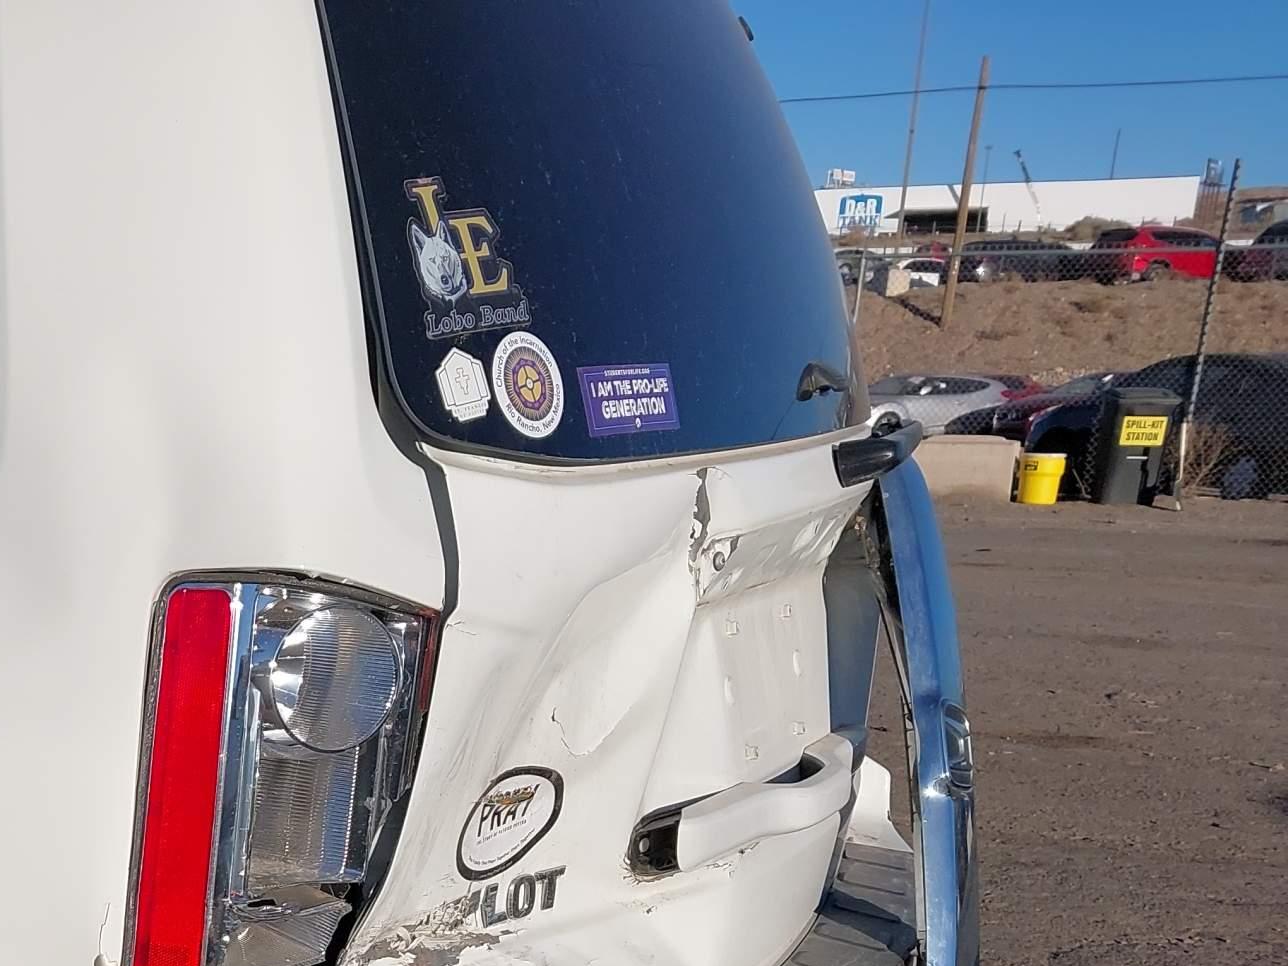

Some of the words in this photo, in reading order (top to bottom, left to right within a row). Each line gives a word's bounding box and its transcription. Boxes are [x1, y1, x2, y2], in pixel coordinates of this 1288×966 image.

[845, 198, 878, 217] D&R
[426, 309, 476, 336] Lobo
[479, 299, 530, 327] Band
[495, 354, 505, 388] Church
[590, 382, 597, 397] I
[598, 380, 614, 397] AM
[613, 379, 632, 396] THE
[632, 377, 669, 394] PRO-LIFE
[505, 402, 516, 418] Rio
[601, 396, 666, 419] GENERATION
[1125, 419, 1165, 430] SPILL-KIT
[1125, 431, 1159, 441] STATION
